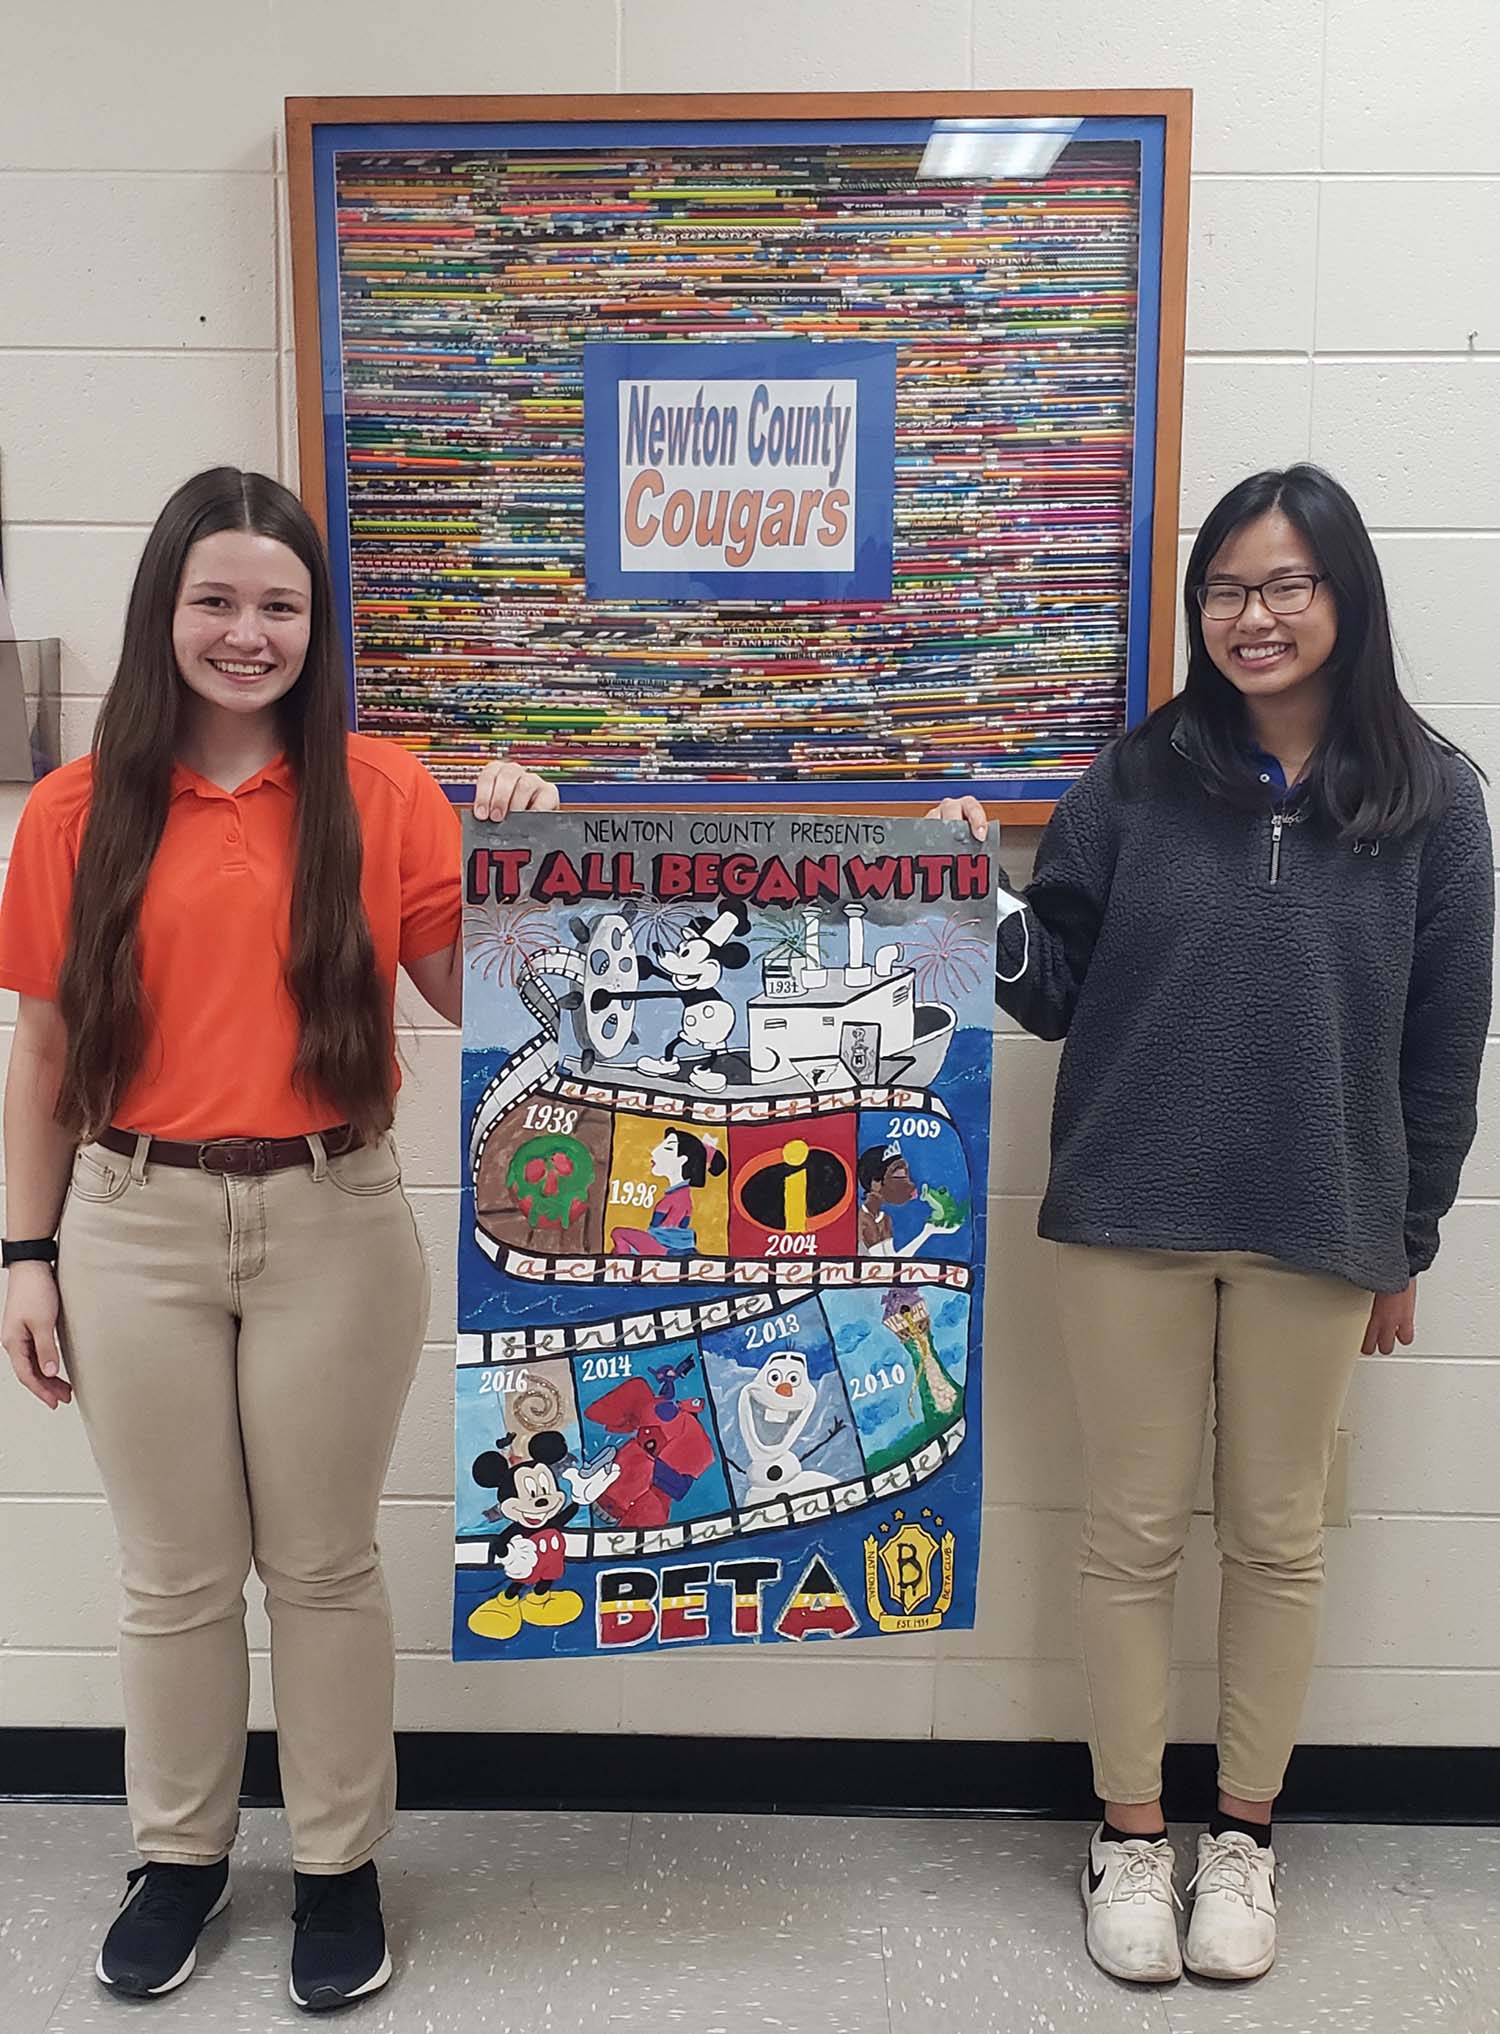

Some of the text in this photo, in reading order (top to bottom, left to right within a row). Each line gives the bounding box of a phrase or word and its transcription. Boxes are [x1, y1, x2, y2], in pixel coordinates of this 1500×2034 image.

[625, 383, 851, 488] Newton County
[624, 468, 850, 567] Cougars
[584, 820, 886, 846] NEWTON COUNTY PRESENTS
[467, 849, 992, 905] IT ALL BEGAN WITH
[521, 1104, 578, 1135] 1938
[886, 1116, 941, 1139] 2009
[608, 1178, 657, 1209] 1998
[764, 1233, 818, 1257] 2004
[515, 1257, 967, 1286] achievement
[501, 1294, 772, 1357] service
[744, 1314, 802, 1350] 2013
[479, 1368, 529, 1394] 2016
[581, 1353, 633, 1383] 2014
[849, 1364, 906, 1400] 2010
[609, 1427, 964, 1555] character
[596, 1553, 863, 1649] BETA
